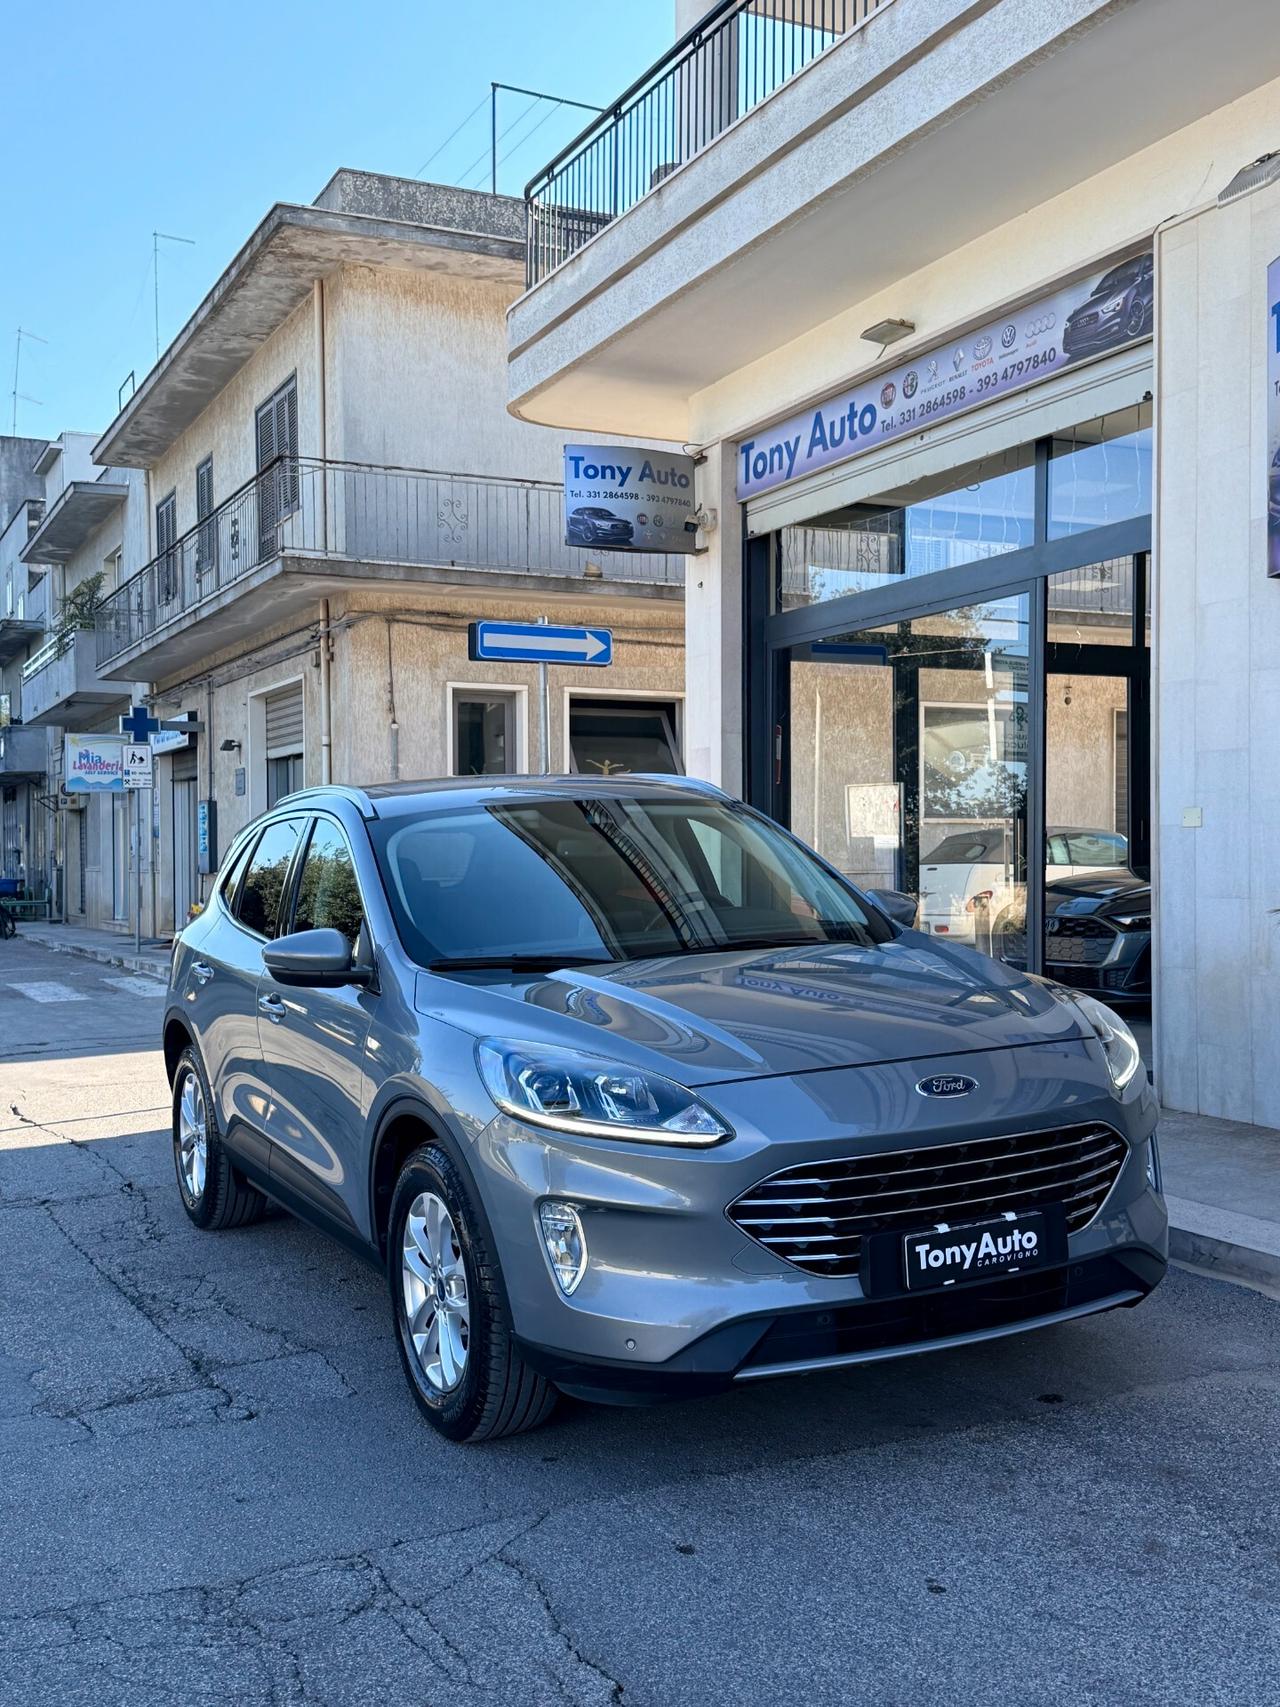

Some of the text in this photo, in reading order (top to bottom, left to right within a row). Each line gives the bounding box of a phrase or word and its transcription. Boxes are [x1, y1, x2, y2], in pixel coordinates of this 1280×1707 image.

[971, 356, 995, 373] TOYOTA
[881, 416, 897, 433] Tel.
[899, 407, 916, 425] 331
[919, 384, 966, 417] 2864598
[976, 373, 998, 394] 393
[1001, 346, 1057, 382] 4797840
[740, 402, 877, 484] Tony Auto
[569, 455, 690, 489] Tony Auto
[570, 490, 584, 498] Tel.
[586, 490, 600, 499] 331
[603, 491, 639, 501] 2864598
[646, 494, 660, 502] 393
[661, 495, 692, 507] 4797840
[78, 748, 102, 764] Mia
[932, 1077, 966, 1093] Ford
[976, 1248, 1039, 1267] CAROVIGNO
